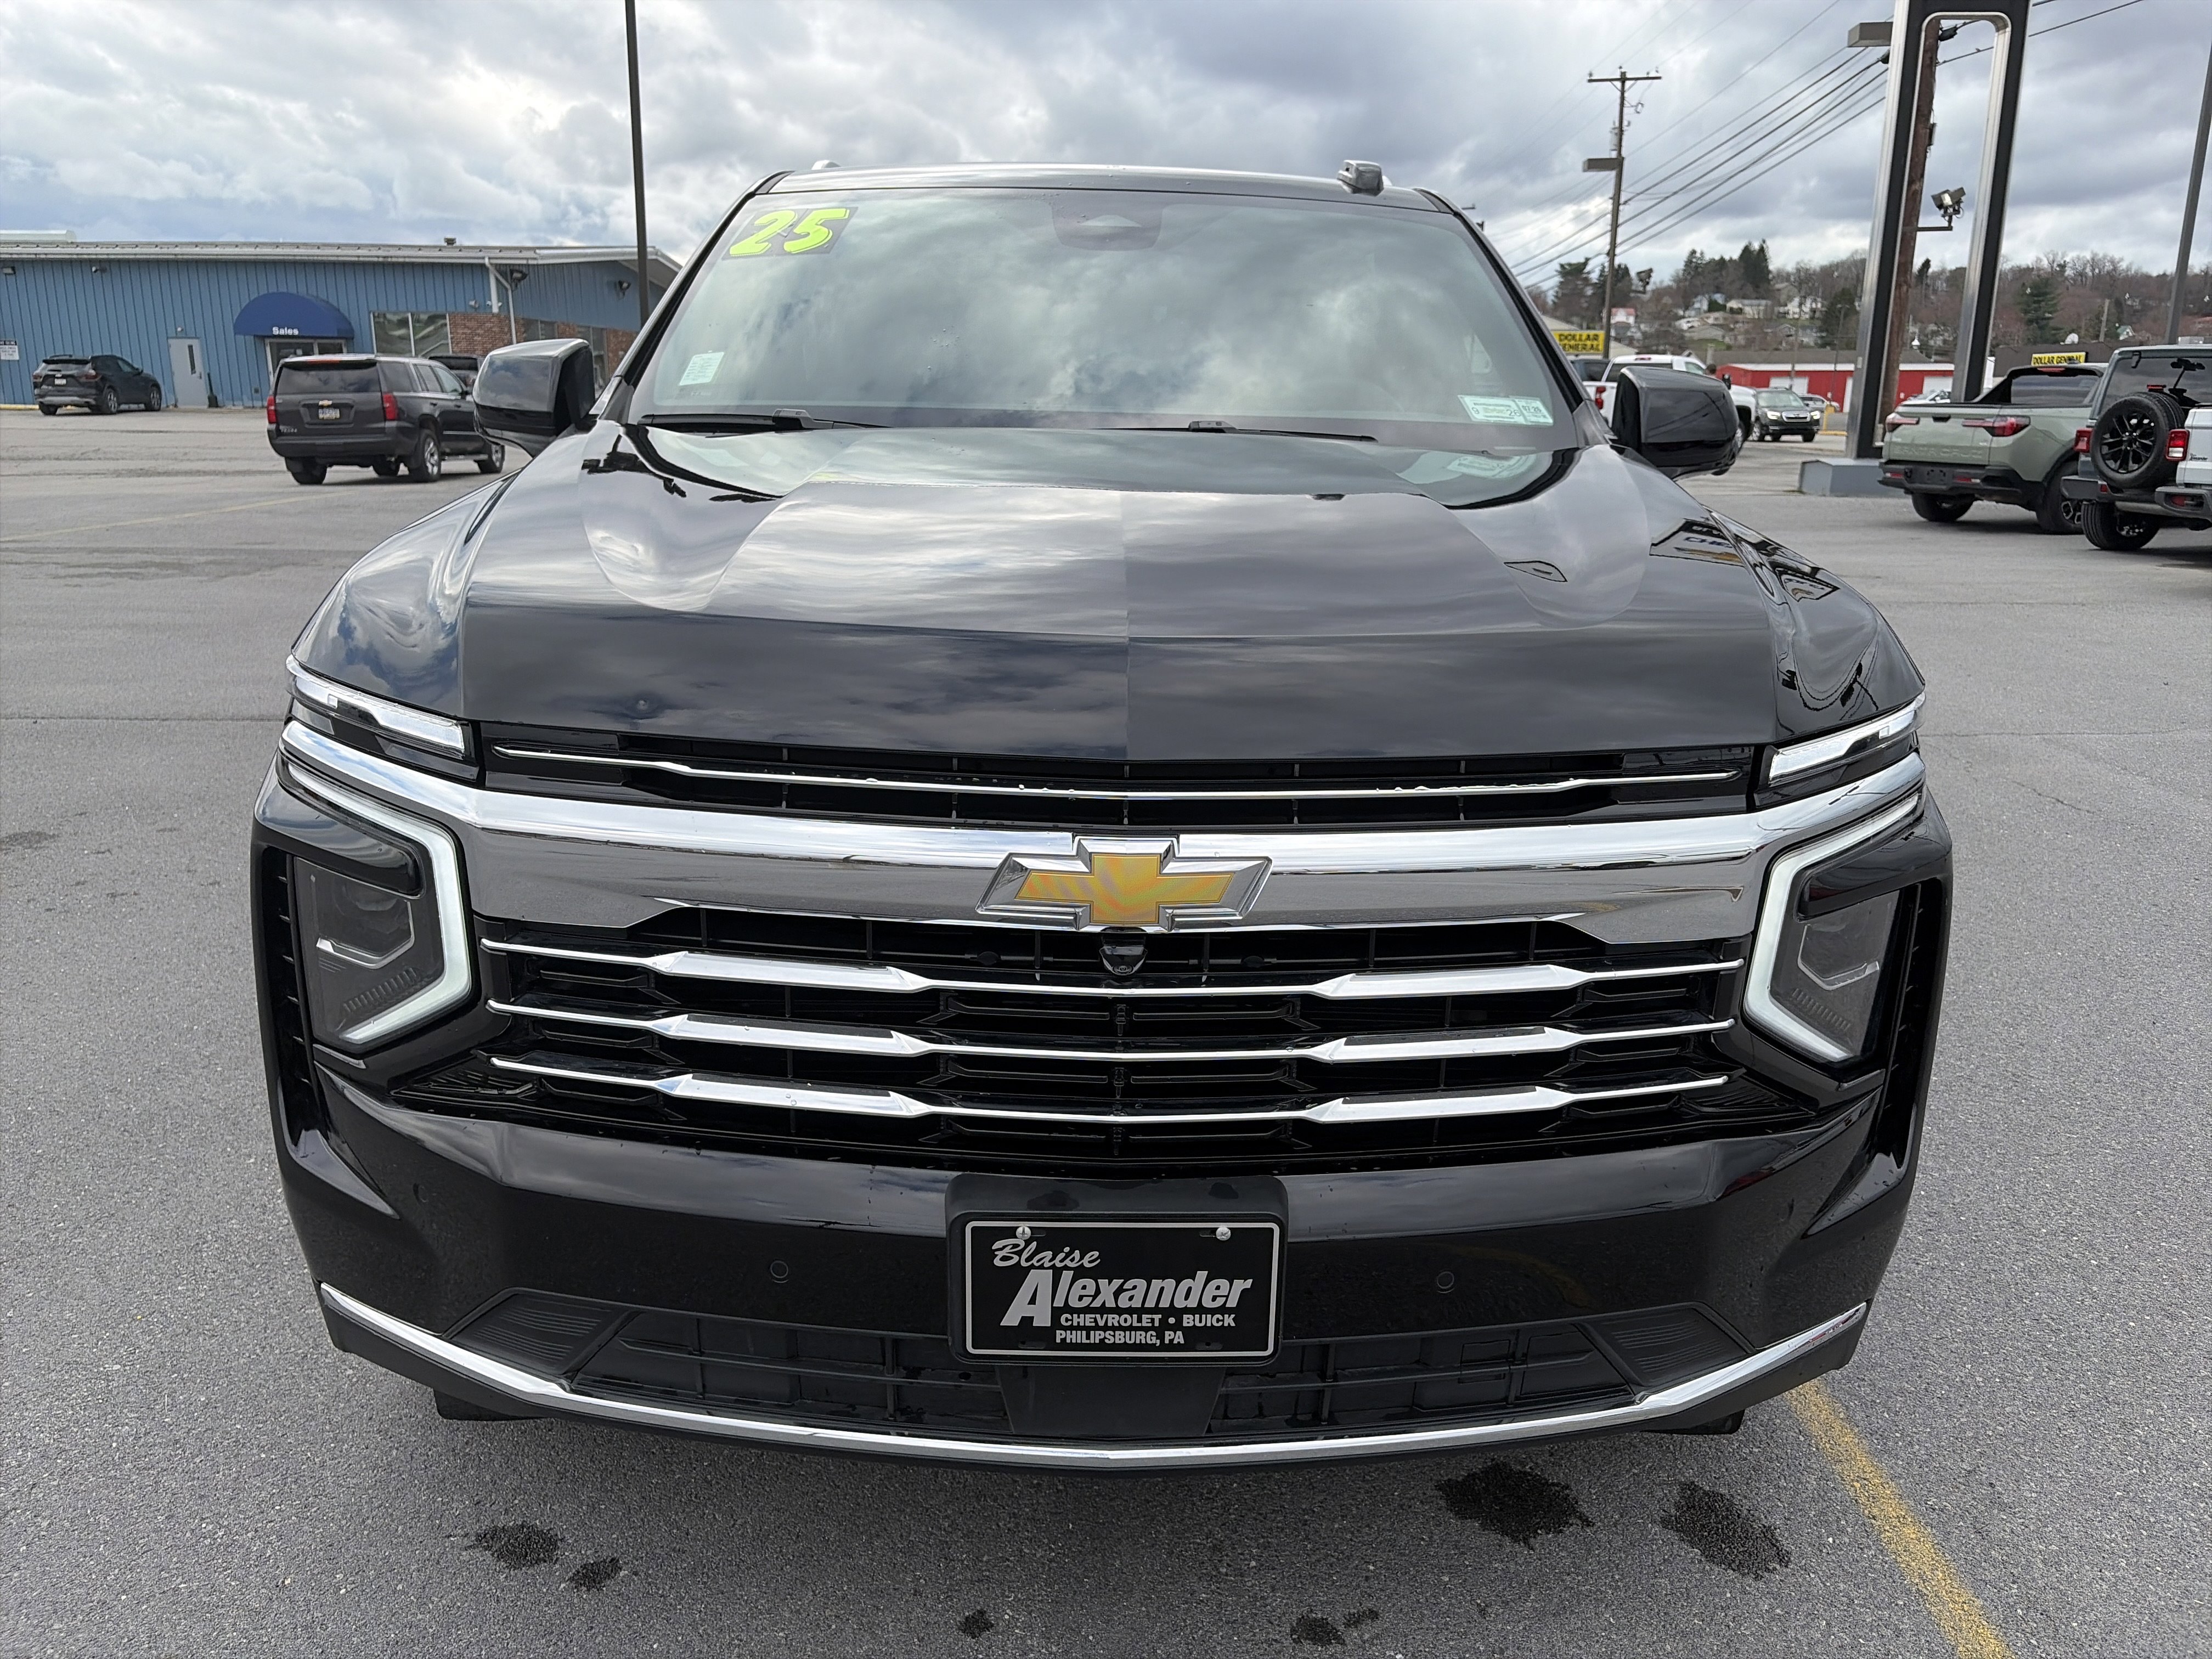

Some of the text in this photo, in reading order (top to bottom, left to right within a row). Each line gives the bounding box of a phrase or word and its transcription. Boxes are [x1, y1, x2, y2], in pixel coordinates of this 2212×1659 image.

[730, 208, 850, 257] 25
[272, 326, 299, 335] Sales
[1559, 333, 1599, 341] DOLLAR
[1560, 343, 1600, 351] ENERAL
[1506, 409, 1521, 417] 26
[991, 1238, 1101, 1268] Blaise
[1000, 1269, 1253, 1327] Alexander
[1060, 1313, 1235, 1327] CHEVROLET BUICK
[1056, 1330, 1185, 1346] PHILIPSBURG, PA
